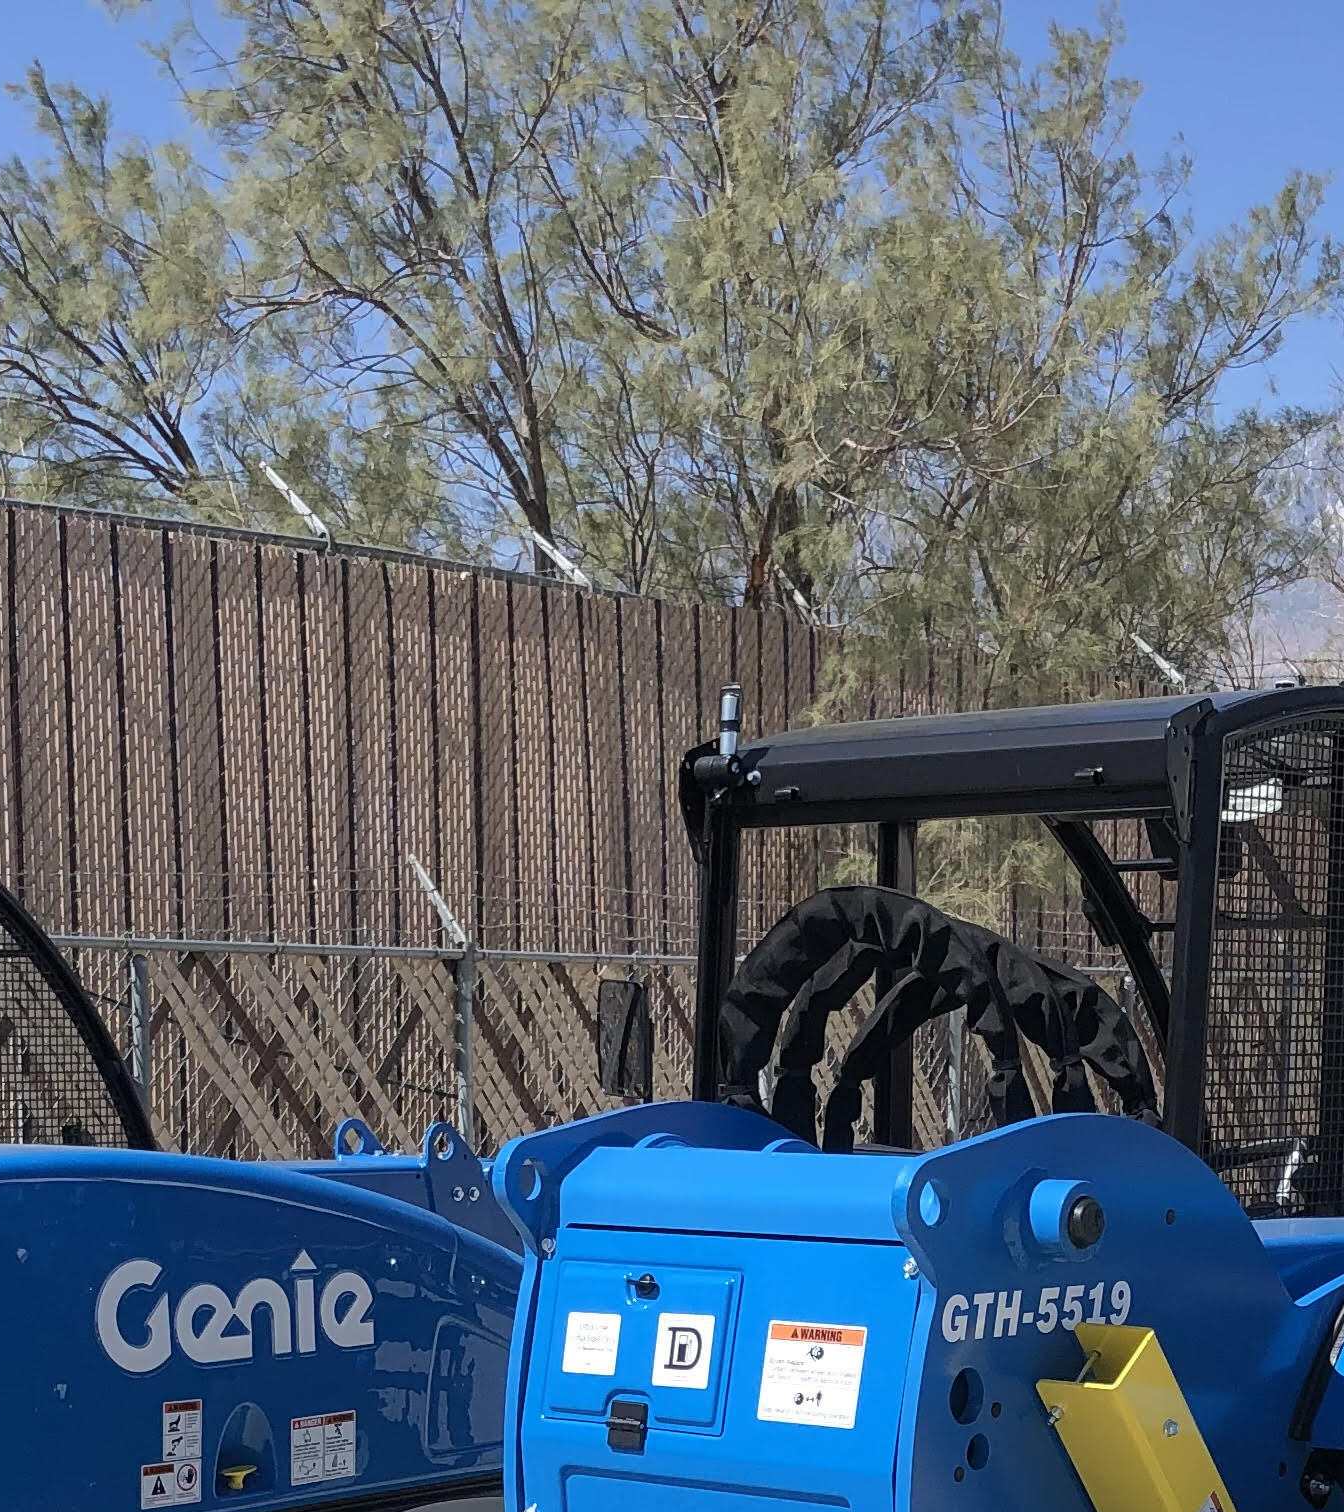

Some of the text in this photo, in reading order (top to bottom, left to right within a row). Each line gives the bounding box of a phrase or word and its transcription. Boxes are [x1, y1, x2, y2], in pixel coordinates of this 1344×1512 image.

[97, 1249, 375, 1374] Genie
[800, 1327, 843, 1342] WARNING
[941, 1280, 1132, 1344] GTH-5519
[663, 1326, 702, 1370] D
